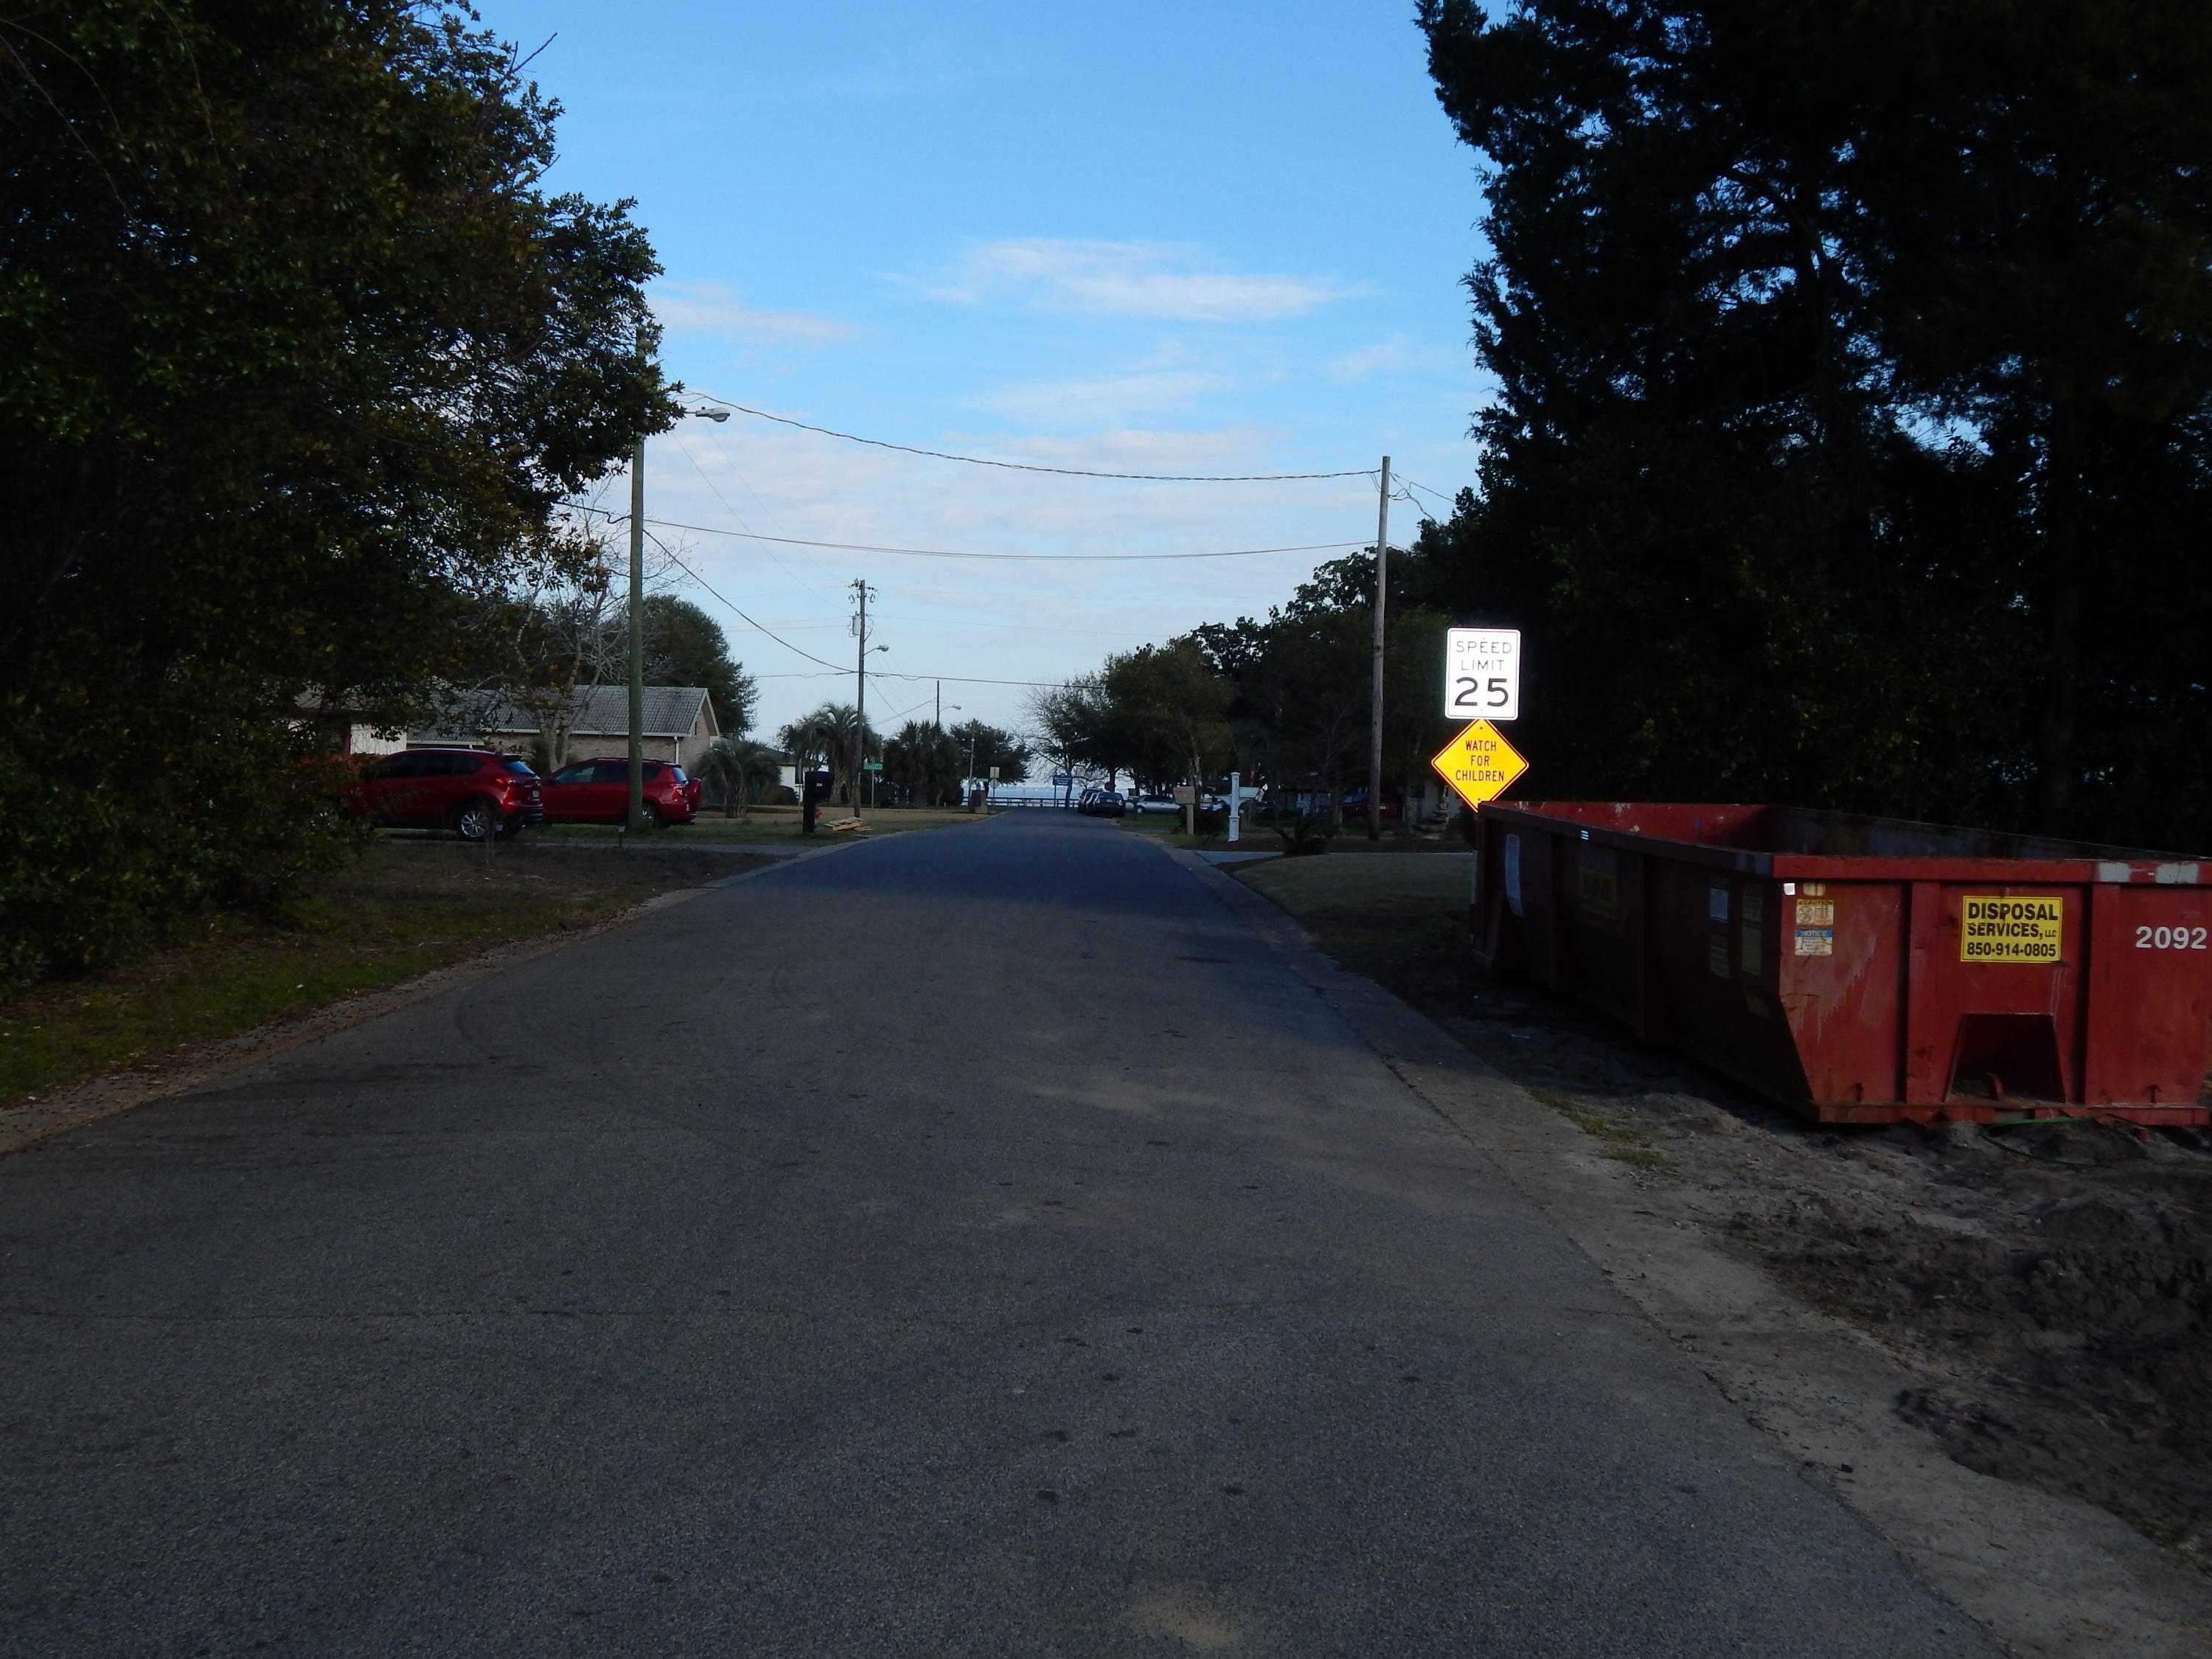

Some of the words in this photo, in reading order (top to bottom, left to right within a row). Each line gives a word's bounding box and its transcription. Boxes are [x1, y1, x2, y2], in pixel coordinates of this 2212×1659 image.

[1455, 641, 1512, 653] SPEED
[1461, 659, 1504, 671] LIMIT
[1454, 676, 1509, 707] 25
[1465, 740, 1497, 752] WATCH
[1470, 755, 1490, 767] FOR
[1455, 770, 1504, 782] CHILDREN
[1968, 902, 2059, 920] DISPOSAL
[1966, 922, 2043, 940] SERVICES,
[2045, 929, 2057, 938] LLC
[2135, 925, 2208, 949] 2092
[1966, 942, 2056, 957] 850-914-0805
